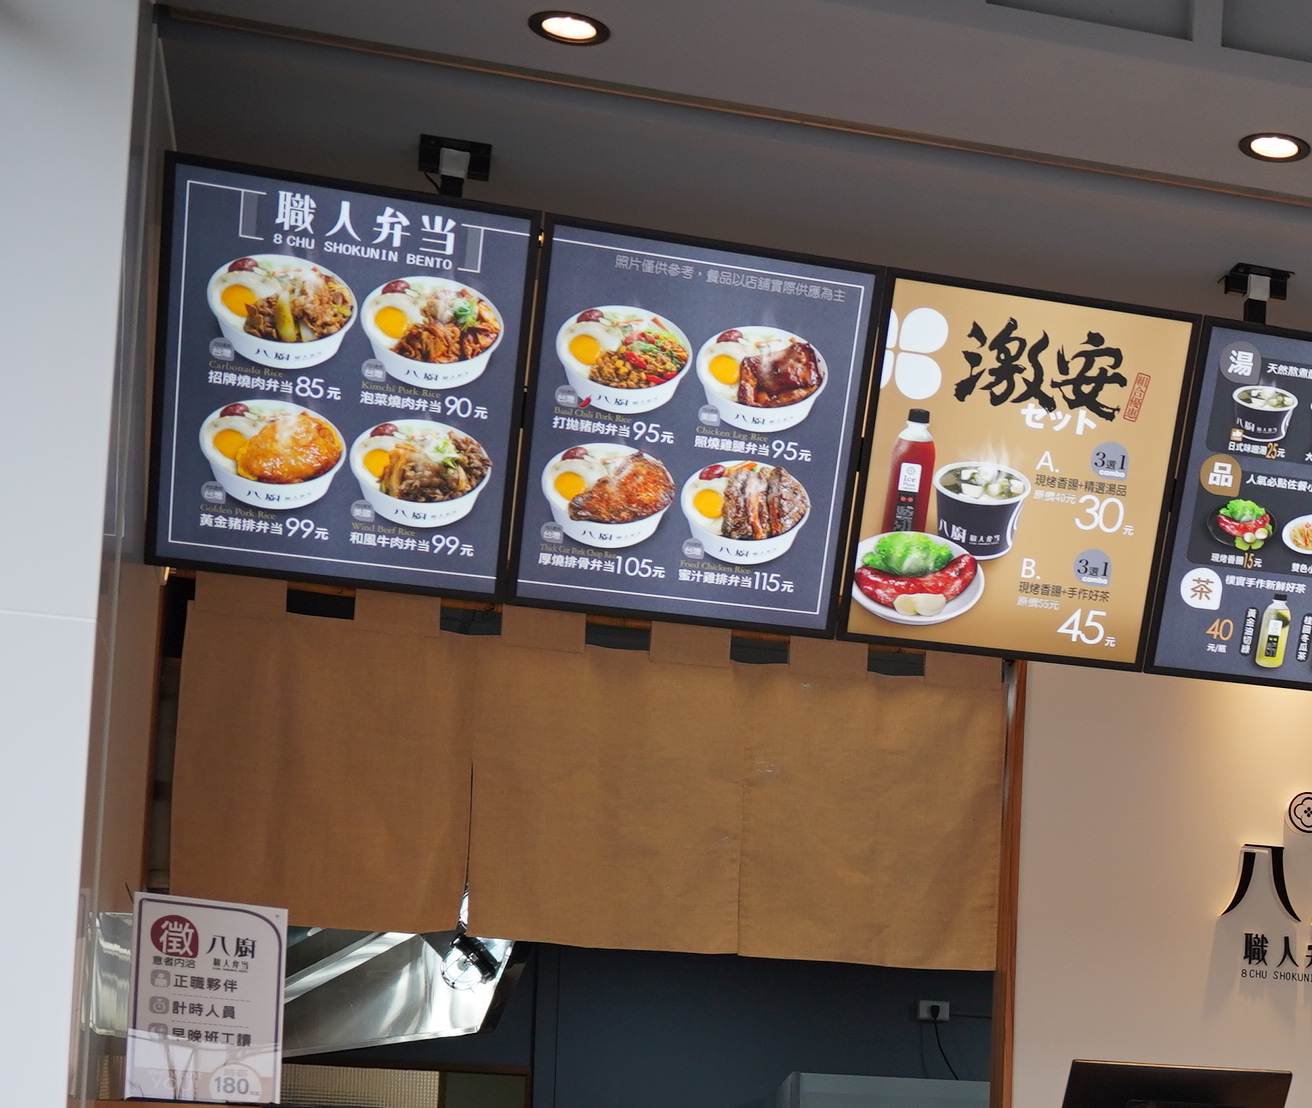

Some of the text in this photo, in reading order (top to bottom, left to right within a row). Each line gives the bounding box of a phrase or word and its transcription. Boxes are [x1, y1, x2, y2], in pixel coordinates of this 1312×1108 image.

[275, 190, 456, 255] 職人弁当
[273, 234, 453, 270] 8 CHU SHOKUNIN BENTO
[209, 360, 284, 378] Carbonado Rice
[954, 317, 1127, 422] 激安
[1227, 350, 1254, 376] 湯
[361, 381, 441, 399] Kimchi Pork Rice
[615, 414, 632, 423] Rice
[1020, 402, 1097, 436] セット
[696, 425, 768, 442] Chicken Leg Rice
[1035, 450, 1059, 473] A.
[1099, 470, 1126, 478] combo
[1208, 461, 1234, 488] 品
[200, 504, 276, 520] Golden Pork Rice
[378, 525, 396, 534] Beef
[398, 528, 416, 537] Rice
[680, 560, 751, 574] Fried Chicken Rice
[1020, 557, 1041, 580] B.
[1082, 576, 1108, 585] combo
[1191, 577, 1214, 601] 茶
[1206, 618, 1234, 641] 40
[159, 920, 195, 956] 徵
[206, 935, 257, 959] 八廚
[173, 974, 238, 993] 正職夥伴
[172, 1001, 236, 1020] 計時人員
[214, 1077, 249, 1095] 180
